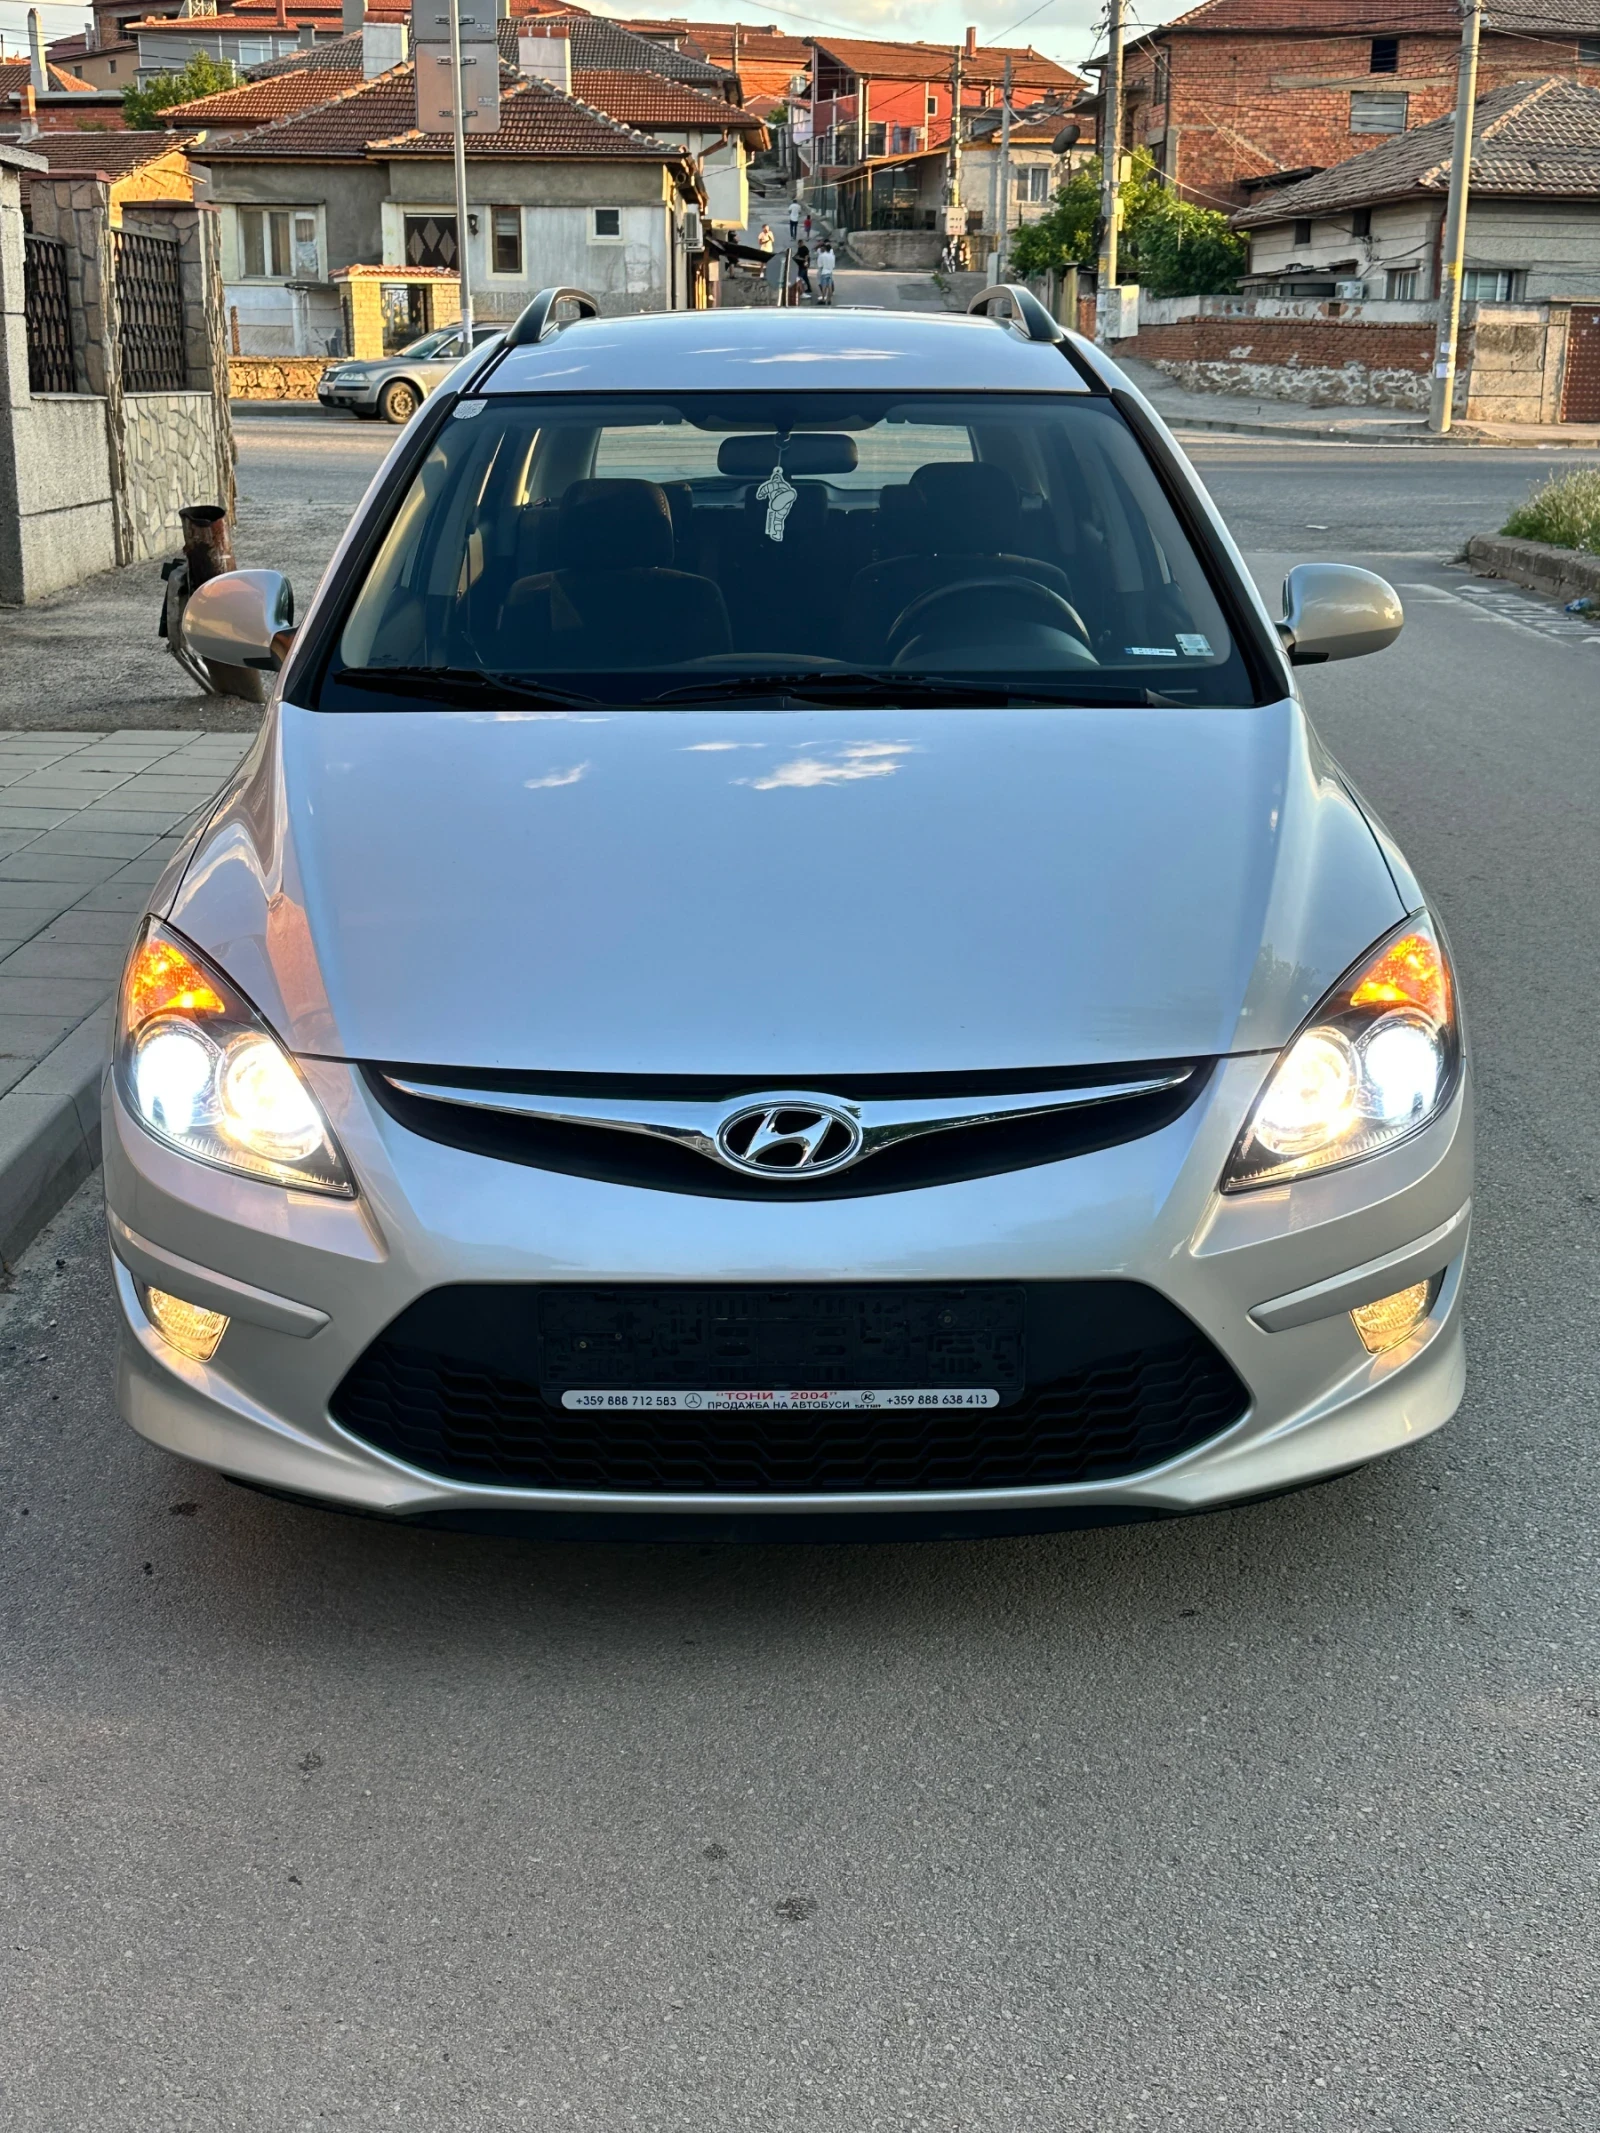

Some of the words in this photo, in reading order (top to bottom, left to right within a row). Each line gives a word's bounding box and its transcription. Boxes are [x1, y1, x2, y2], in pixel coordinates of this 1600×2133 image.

[575, 1395, 605, 1406] +359
[607, 1395, 628, 1406] 888
[632, 1395, 653, 1406] 712
[656, 1396, 677, 1406] 583
[707, 1401, 770, 1411] ПРОДАЖБА
[773, 1401, 789, 1409] НА
[791, 1400, 851, 1409] АВТОБУСИ
[886, 1395, 915, 1406] +359
[918, 1395, 939, 1405] 888
[942, 1394, 963, 1405] 638
[966, 1394, 988, 1405] 413
